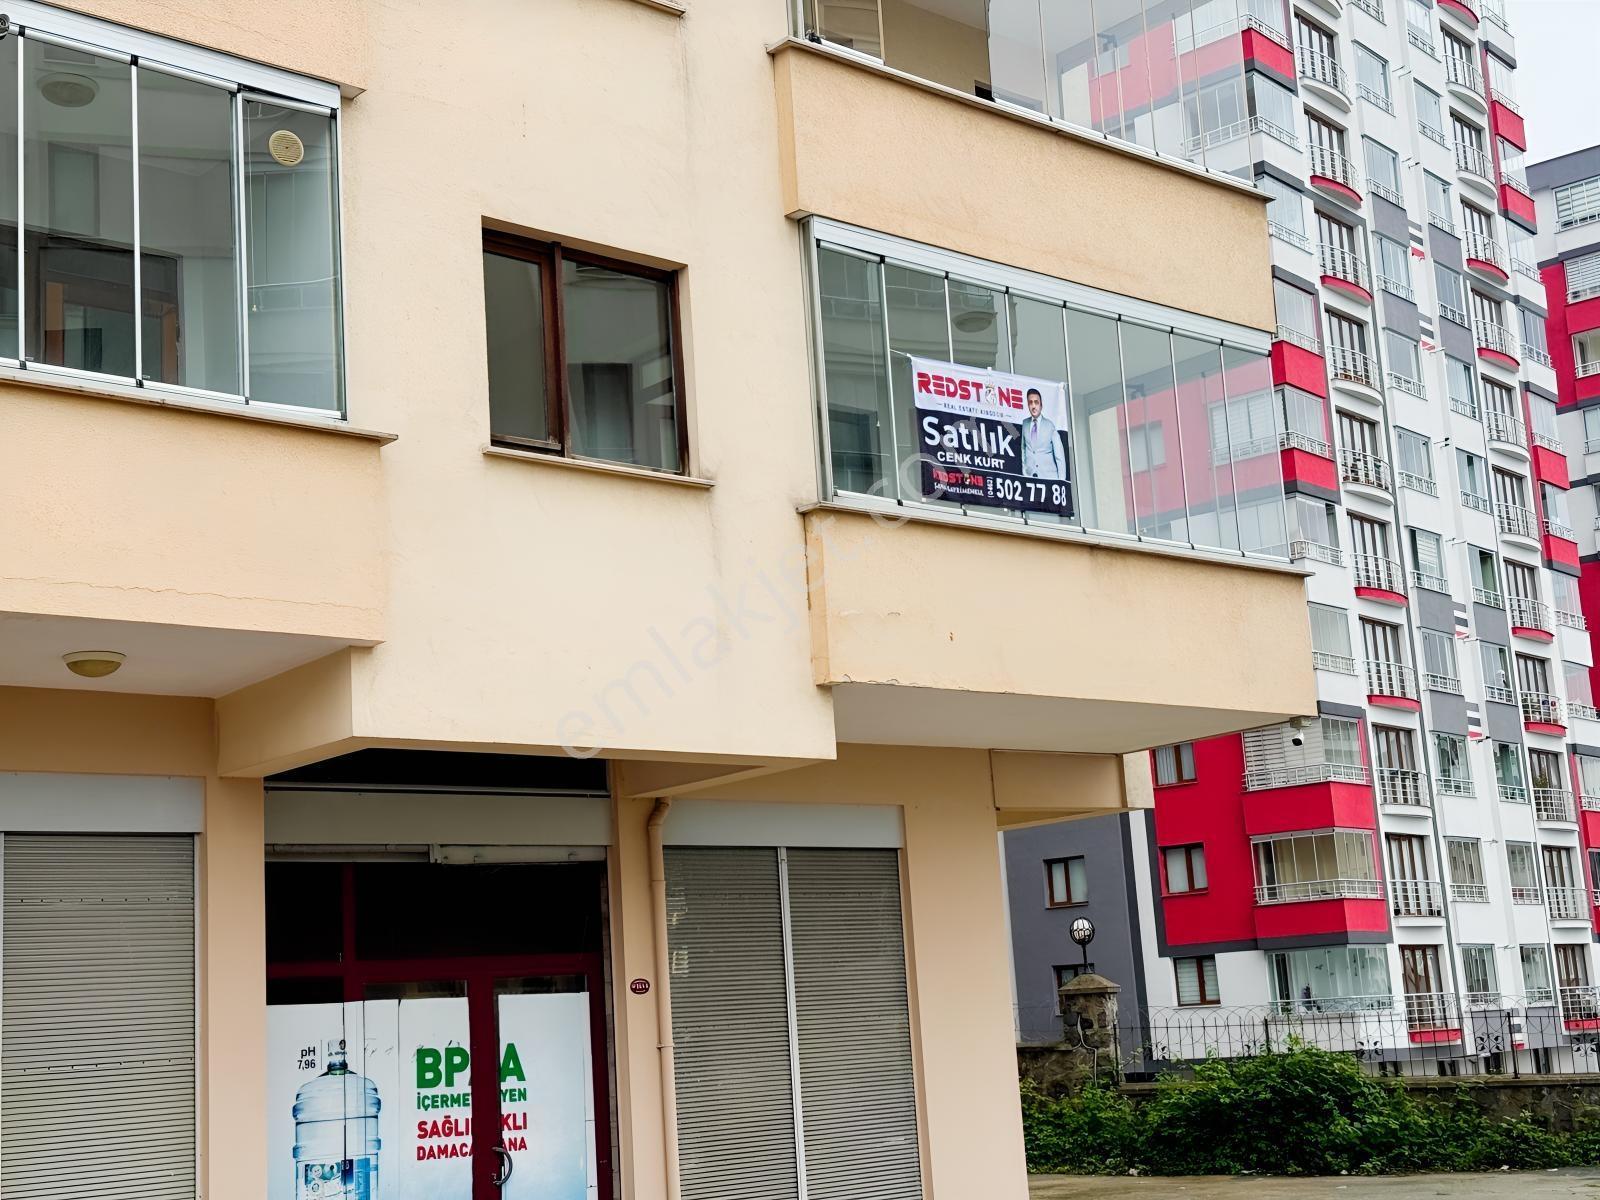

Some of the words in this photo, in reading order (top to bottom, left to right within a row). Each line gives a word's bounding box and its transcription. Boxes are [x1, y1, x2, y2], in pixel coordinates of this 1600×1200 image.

[922, 416, 1016, 457] Satılık
[937, 451, 970, 465] CENK
[974, 457, 1005, 470] KURT
[996, 477, 1023, 502] 502
[1026, 482, 1046, 503] 77
[1051, 484, 1067, 507] 88
[301, 1046, 316, 1059] pH
[297, 1059, 316, 1071] 7,96
